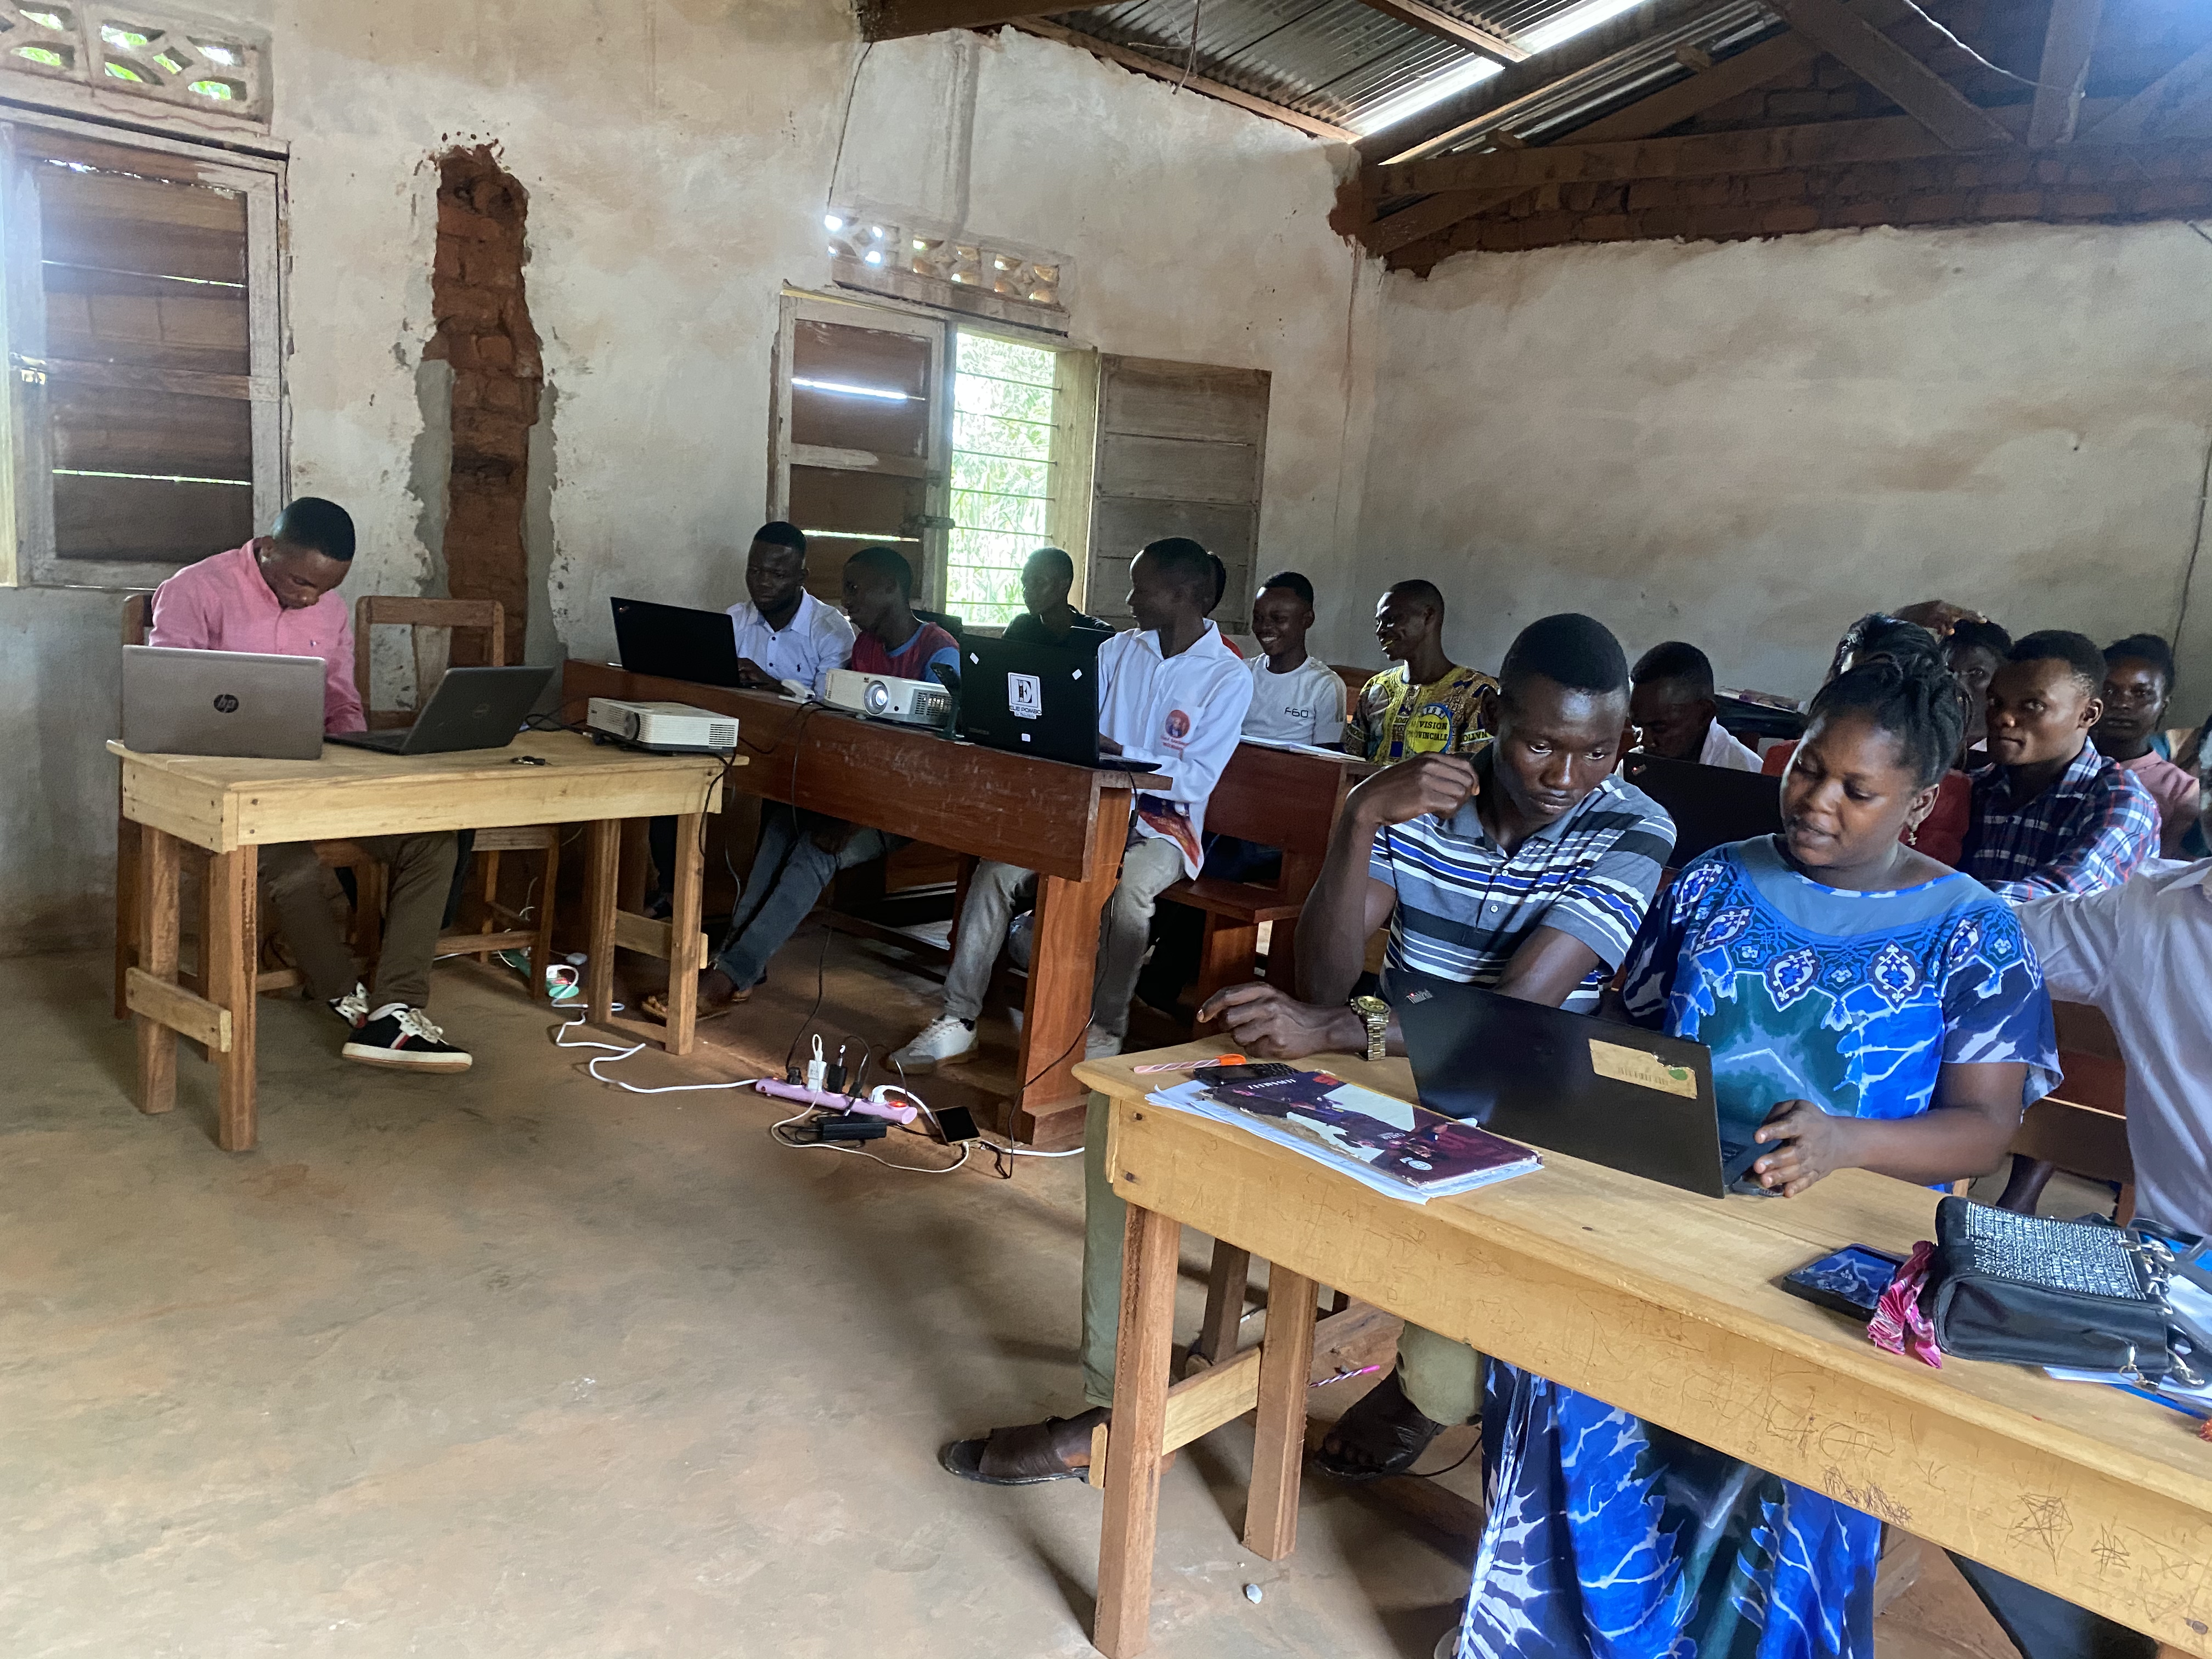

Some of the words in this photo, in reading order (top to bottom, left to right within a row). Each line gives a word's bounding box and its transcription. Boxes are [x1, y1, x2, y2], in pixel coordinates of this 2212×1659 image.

[1016, 679, 1032, 703] E
[217, 695, 236, 713] hp
[1419, 721, 1448, 730] VISION
[1410, 731, 1448, 741] OVINCIALE
[1463, 731, 1488, 742] NATIO
